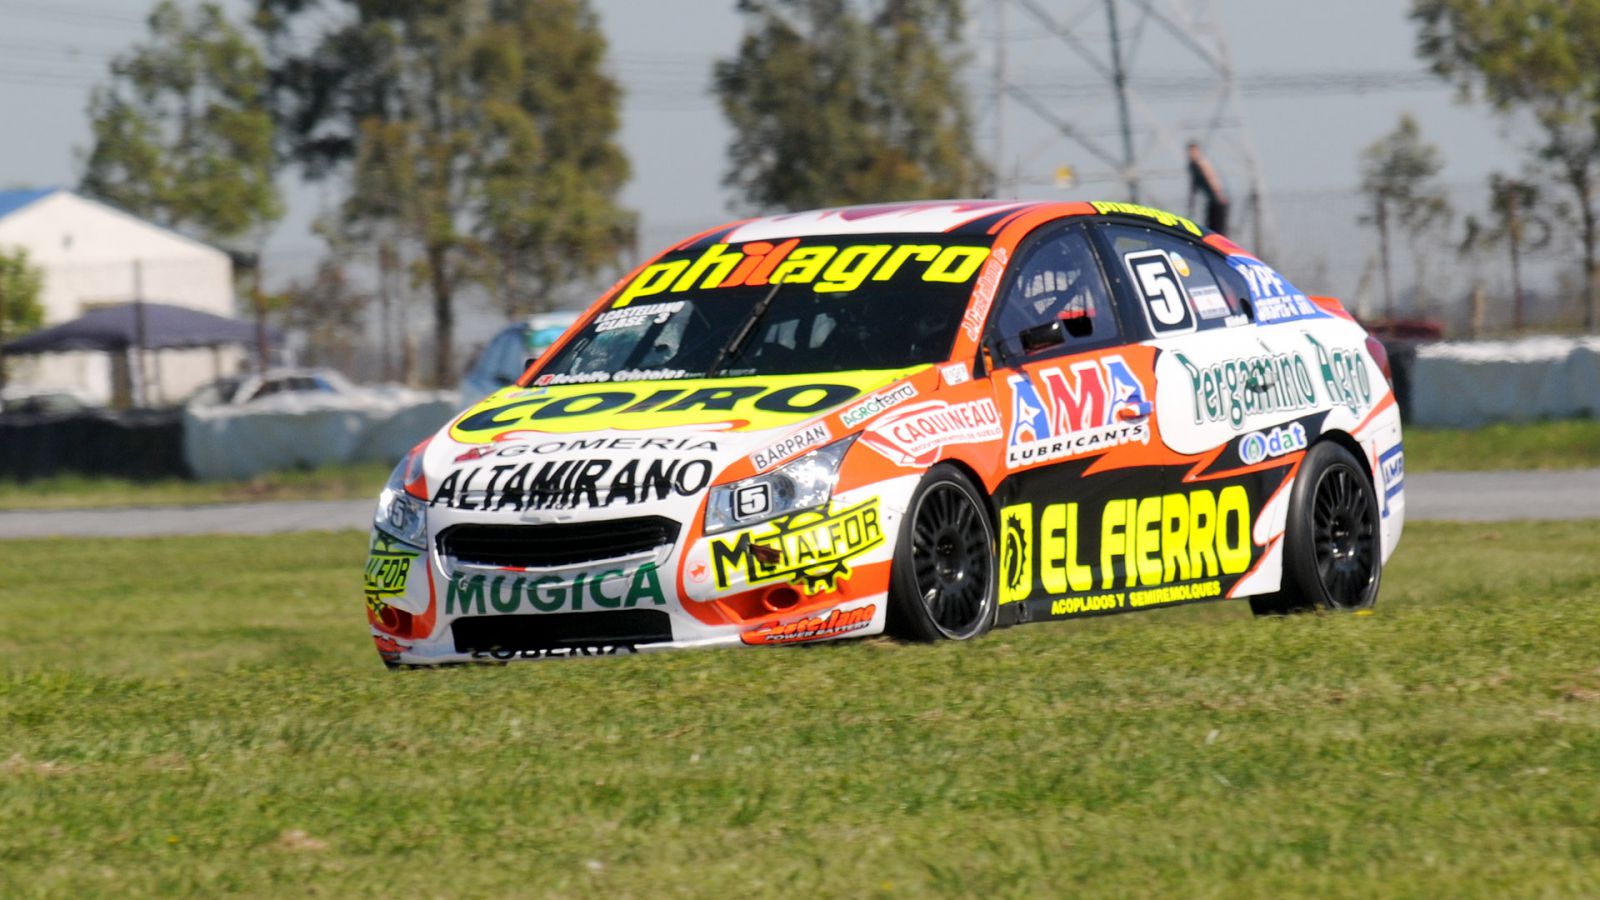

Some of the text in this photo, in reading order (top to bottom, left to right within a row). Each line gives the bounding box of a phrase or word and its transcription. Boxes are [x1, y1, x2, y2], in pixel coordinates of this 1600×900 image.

[612, 239, 991, 308] philagro
[1136, 262, 1185, 325] 5
[1236, 264, 1285, 297] YPF
[1008, 357, 1144, 446] AMA
[1173, 333, 1371, 427] Pergamino Agro
[456, 383, 862, 432] COIRO
[893, 401, 998, 444] CAQUINEAU
[496, 437, 718, 457] GOMERIA
[754, 424, 827, 469] BARPRAN
[1010, 425, 1142, 461] LUBRICANTS
[429, 458, 713, 512] ALTAMIRANO
[740, 487, 767, 515] 5
[1041, 485, 1251, 593] EL FIERRO
[446, 562, 667, 615] MUGICA
[1051, 580, 1221, 615] ACOPLADOS Y SEMIREMOLQUES
